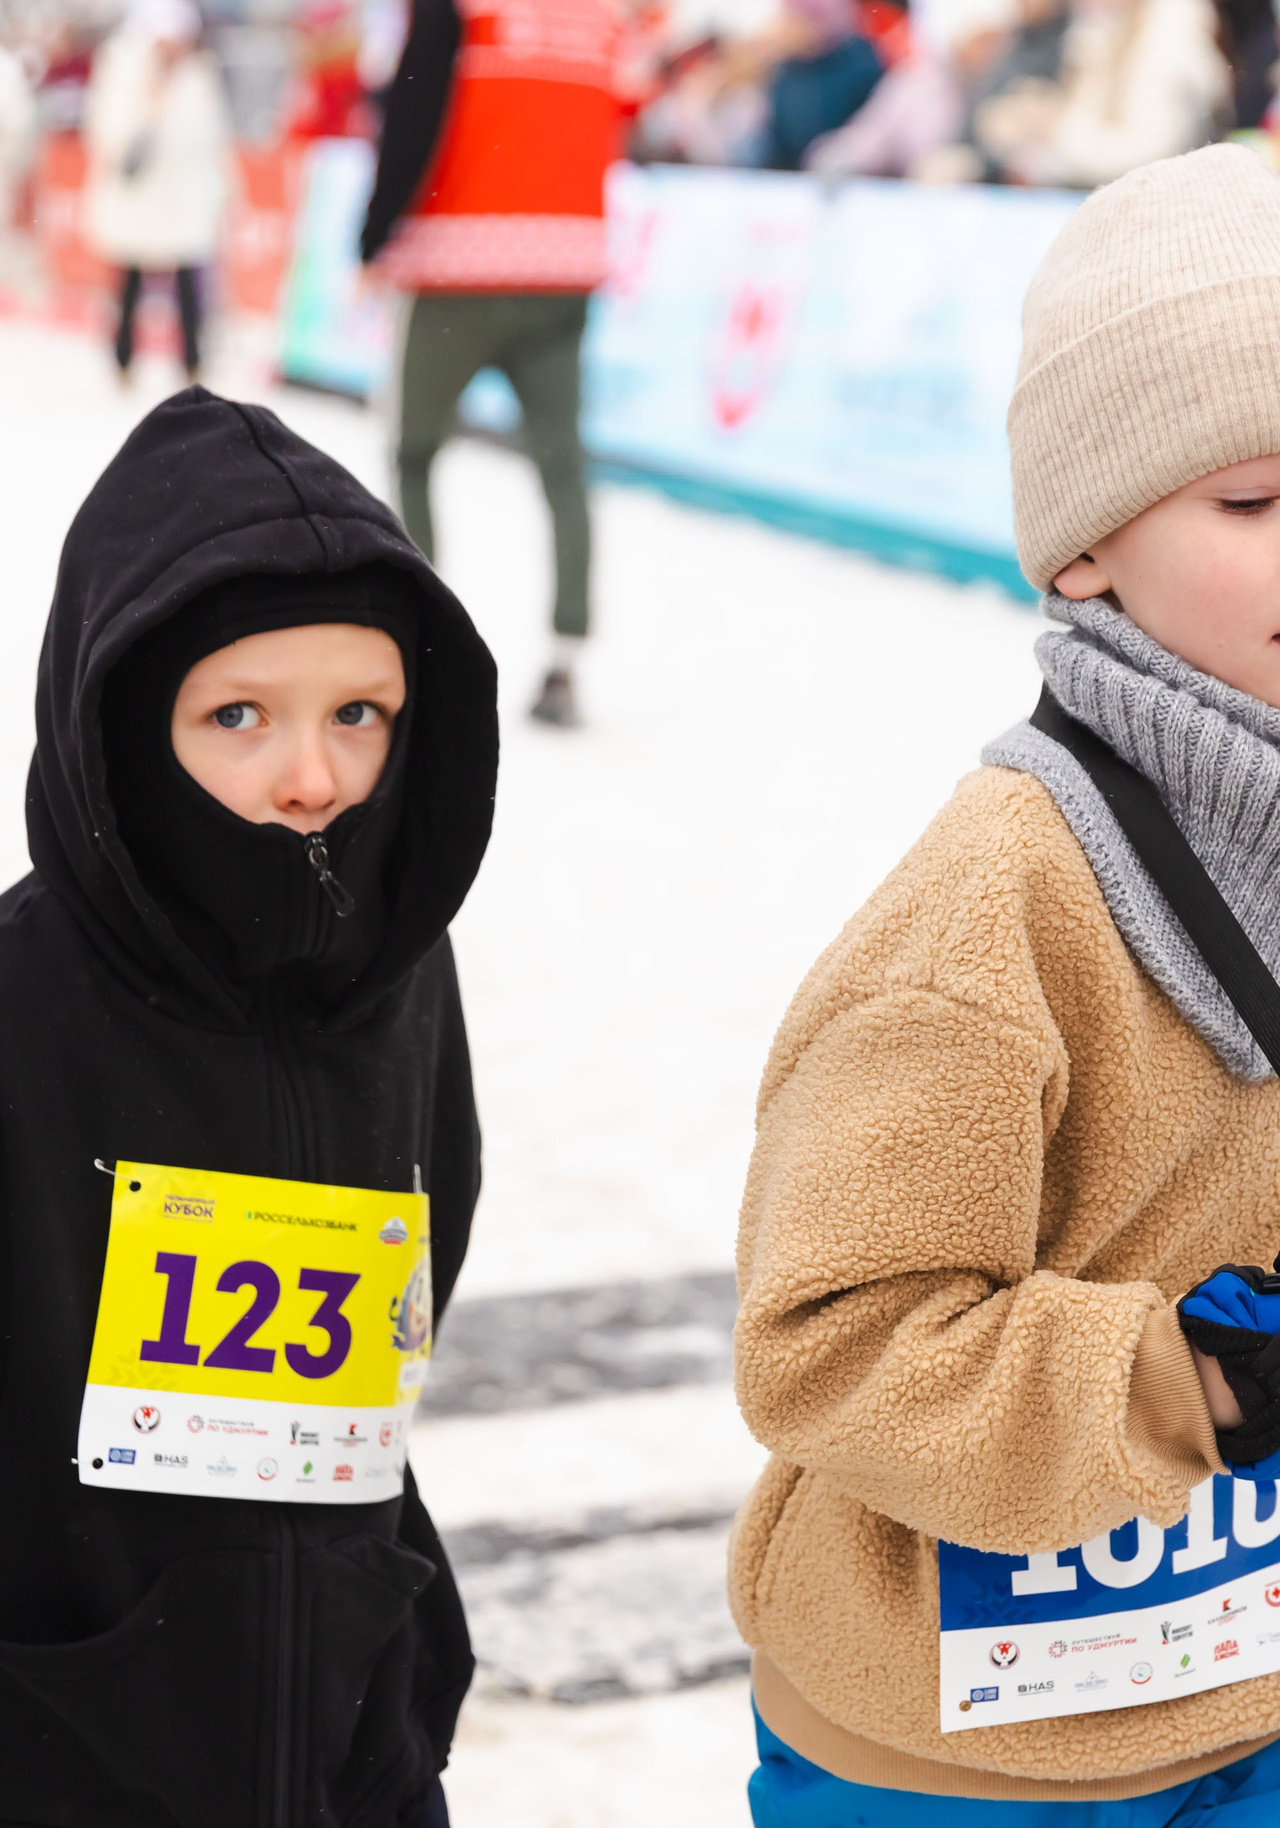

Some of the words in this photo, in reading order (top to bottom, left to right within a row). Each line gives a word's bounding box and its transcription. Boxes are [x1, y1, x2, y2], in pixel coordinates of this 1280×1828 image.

[163, 1201, 214, 1218] КУБОК
[139, 1251, 361, 1379] 123
[1071, 1645, 1085, 1653] ПО
[1088, 1638, 1137, 1652] УДМУРТИИ
[1028, 1680, 1055, 1691] HAS
